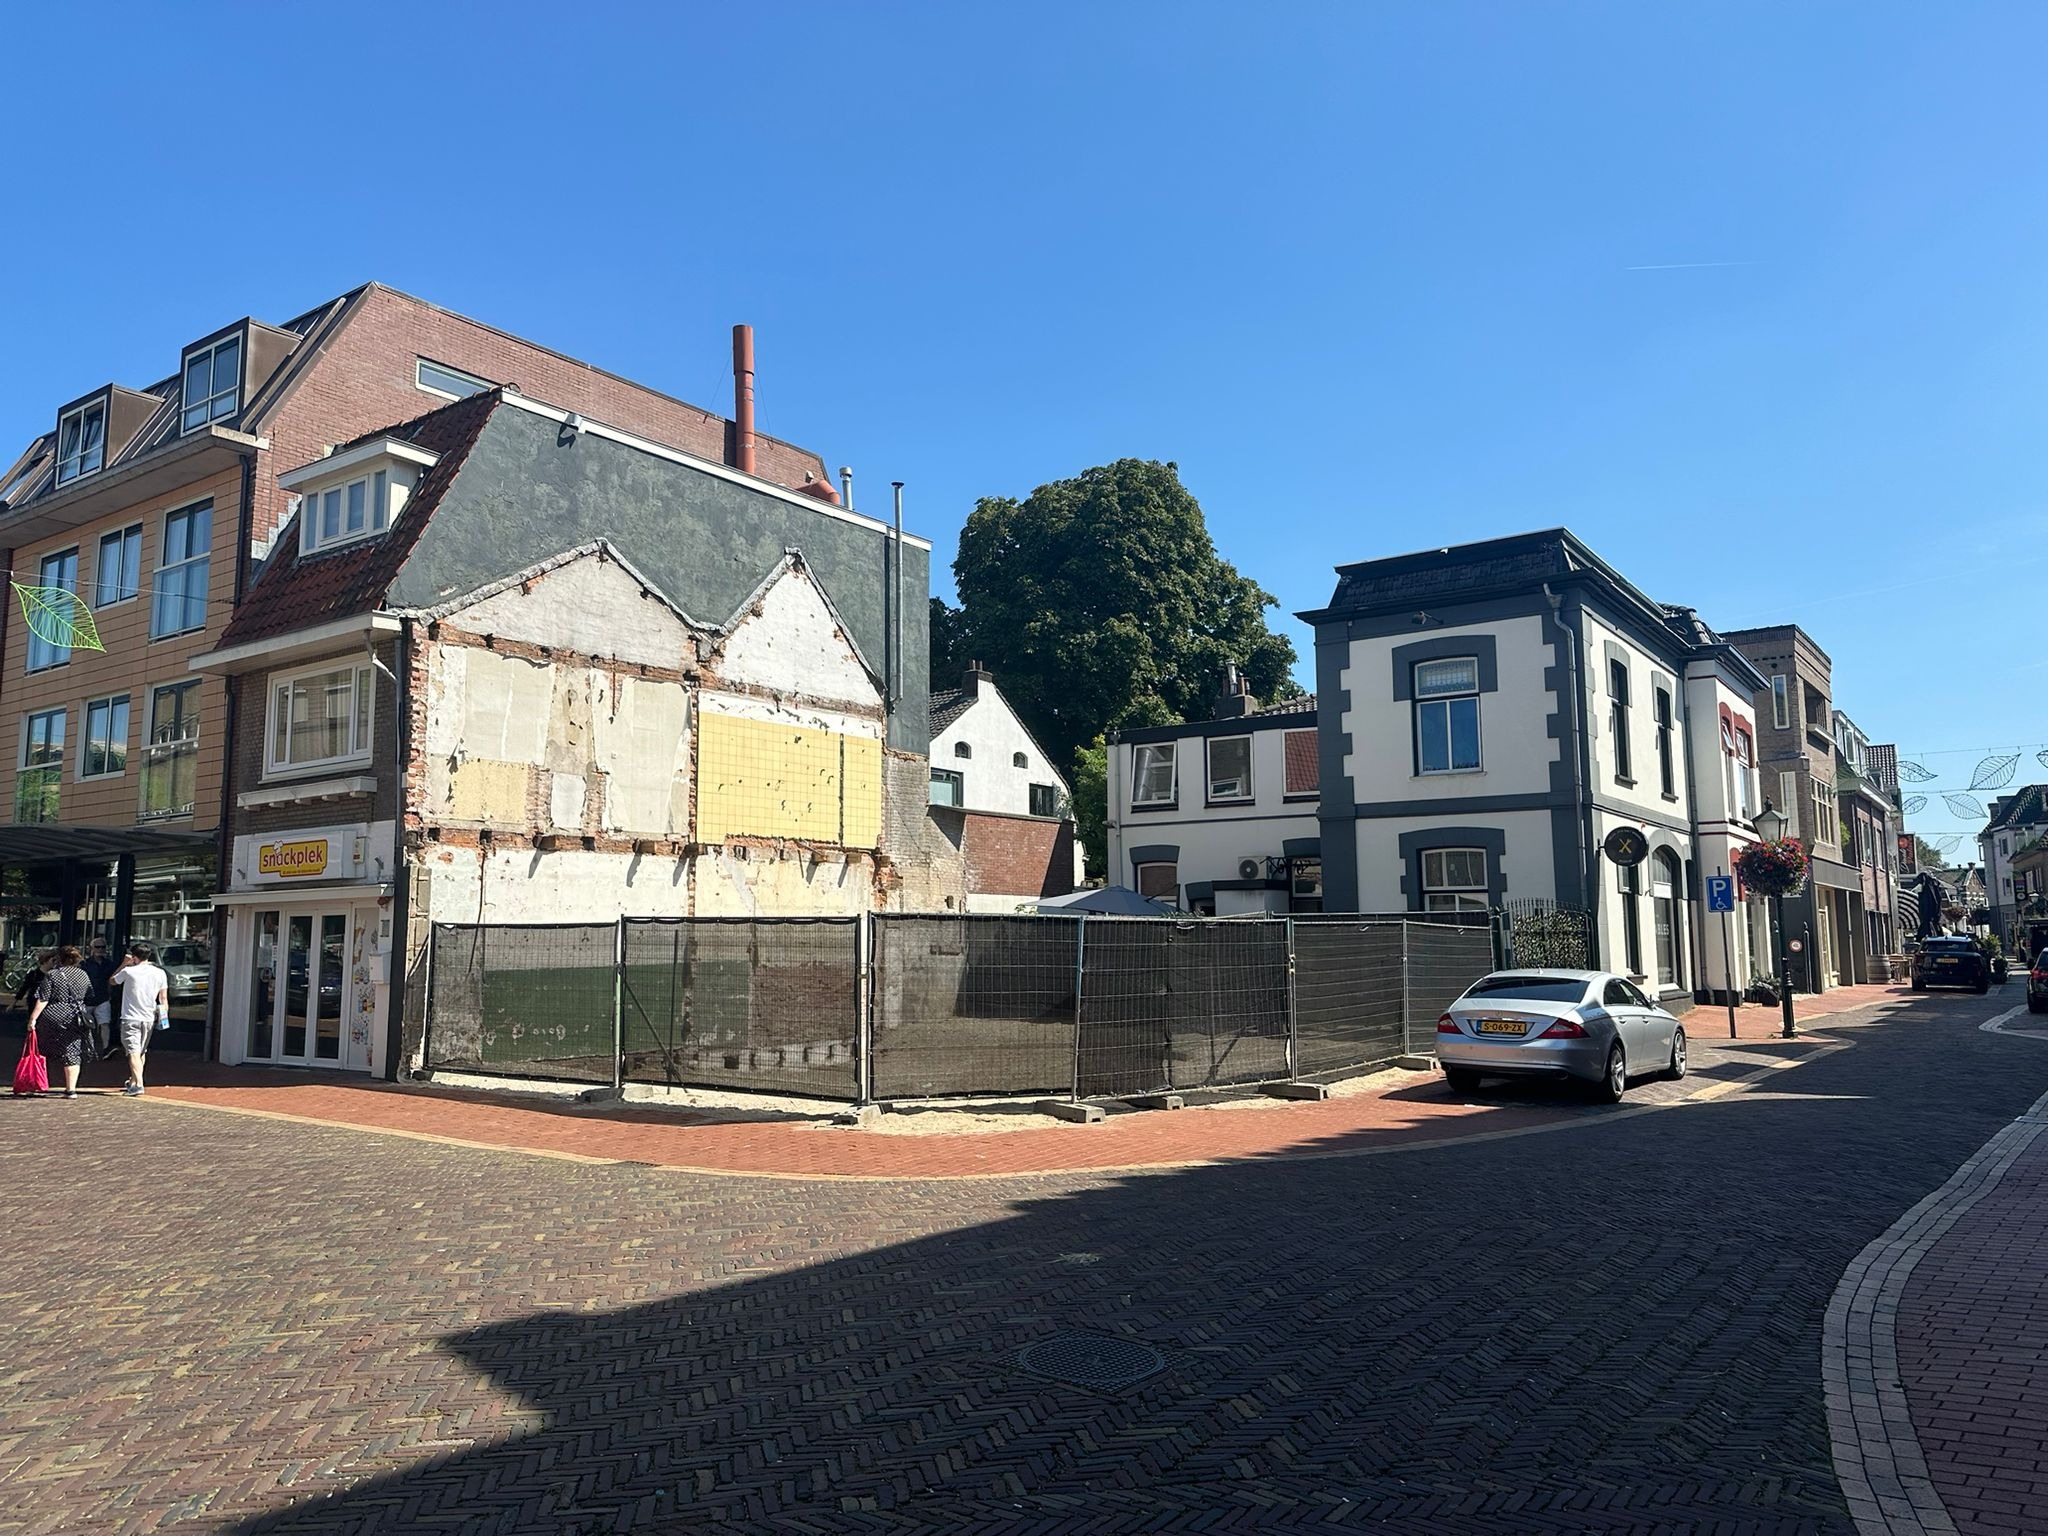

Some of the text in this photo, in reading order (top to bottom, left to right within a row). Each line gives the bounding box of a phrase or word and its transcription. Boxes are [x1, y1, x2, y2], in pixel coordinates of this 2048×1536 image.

[263, 845, 323, 868] snackplek
[1712, 879, 1727, 897] P
[1483, 1022, 1523, 1032] S-069-ZX
